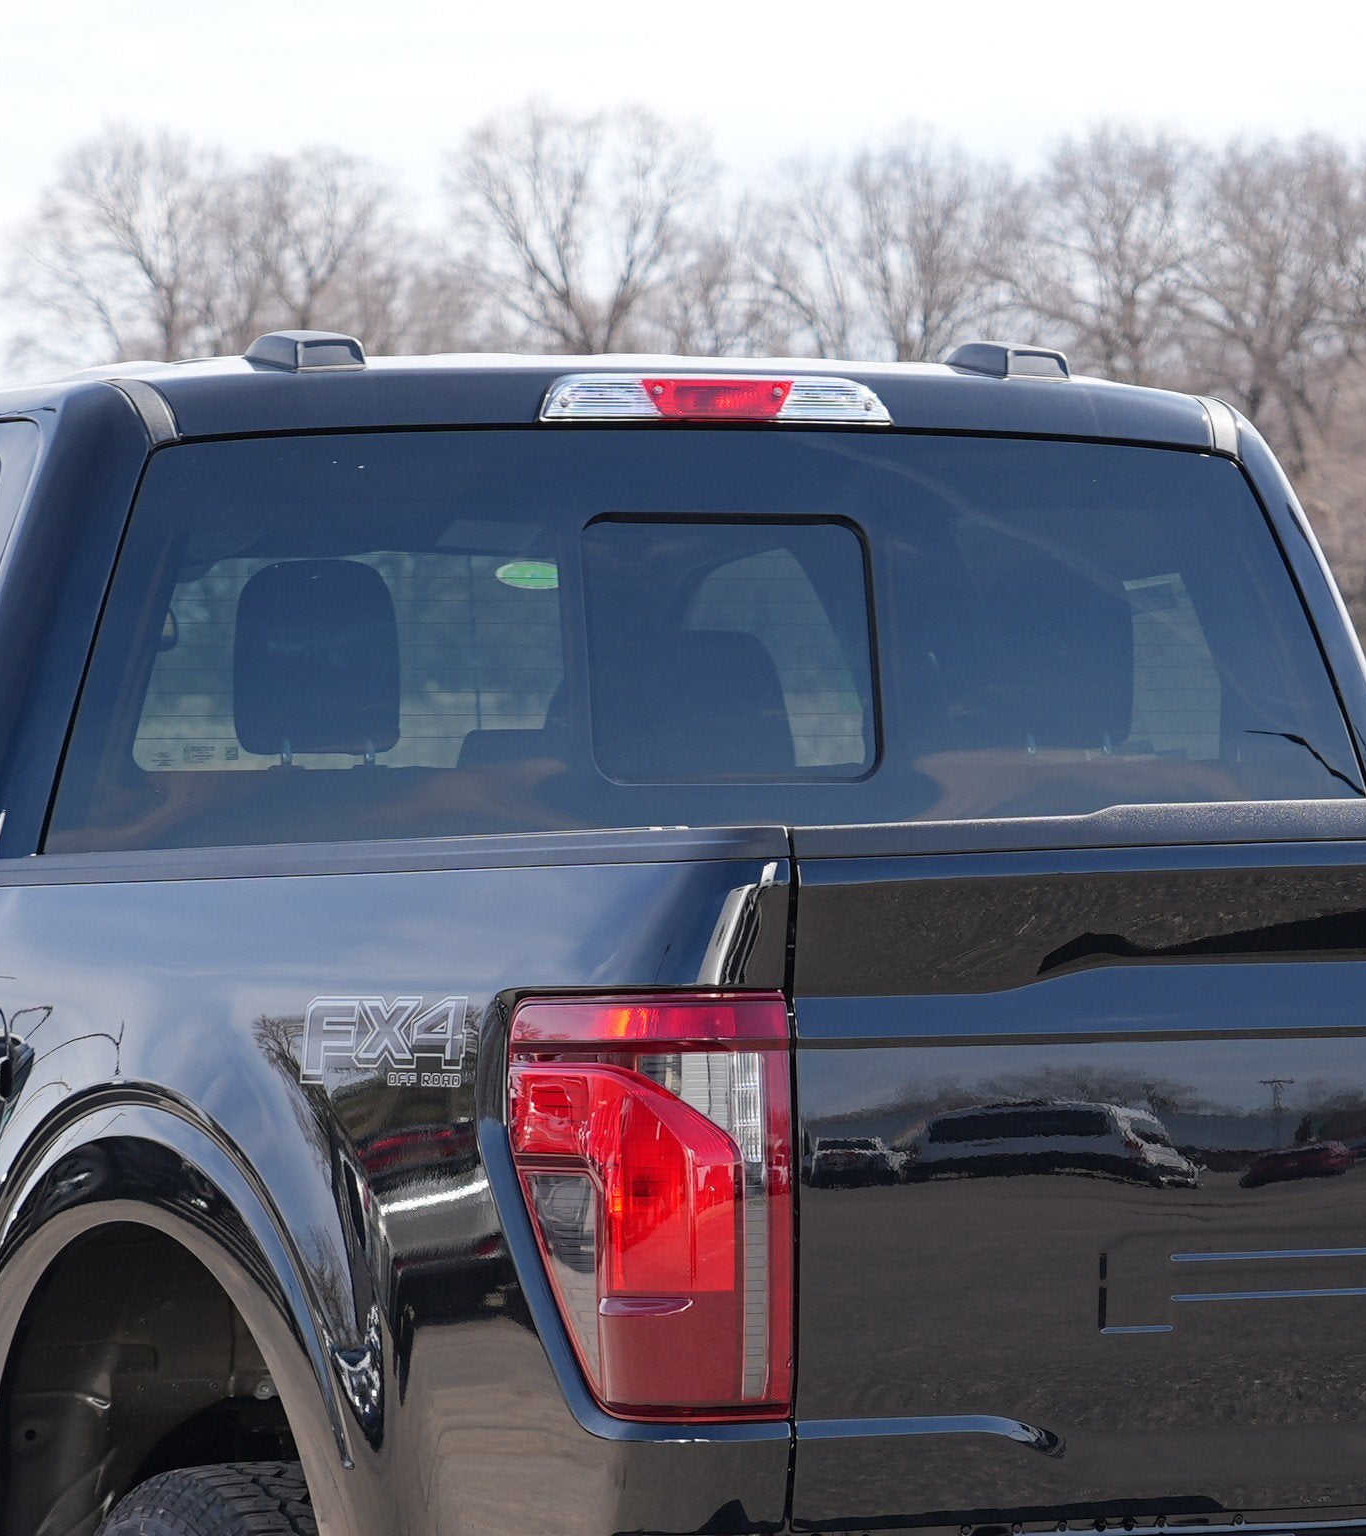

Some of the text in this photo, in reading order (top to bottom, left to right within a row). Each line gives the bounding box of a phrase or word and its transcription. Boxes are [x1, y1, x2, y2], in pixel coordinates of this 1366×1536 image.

[300, 995, 469, 1085] FX4
[387, 1072, 462, 1088] OFF ROAD
